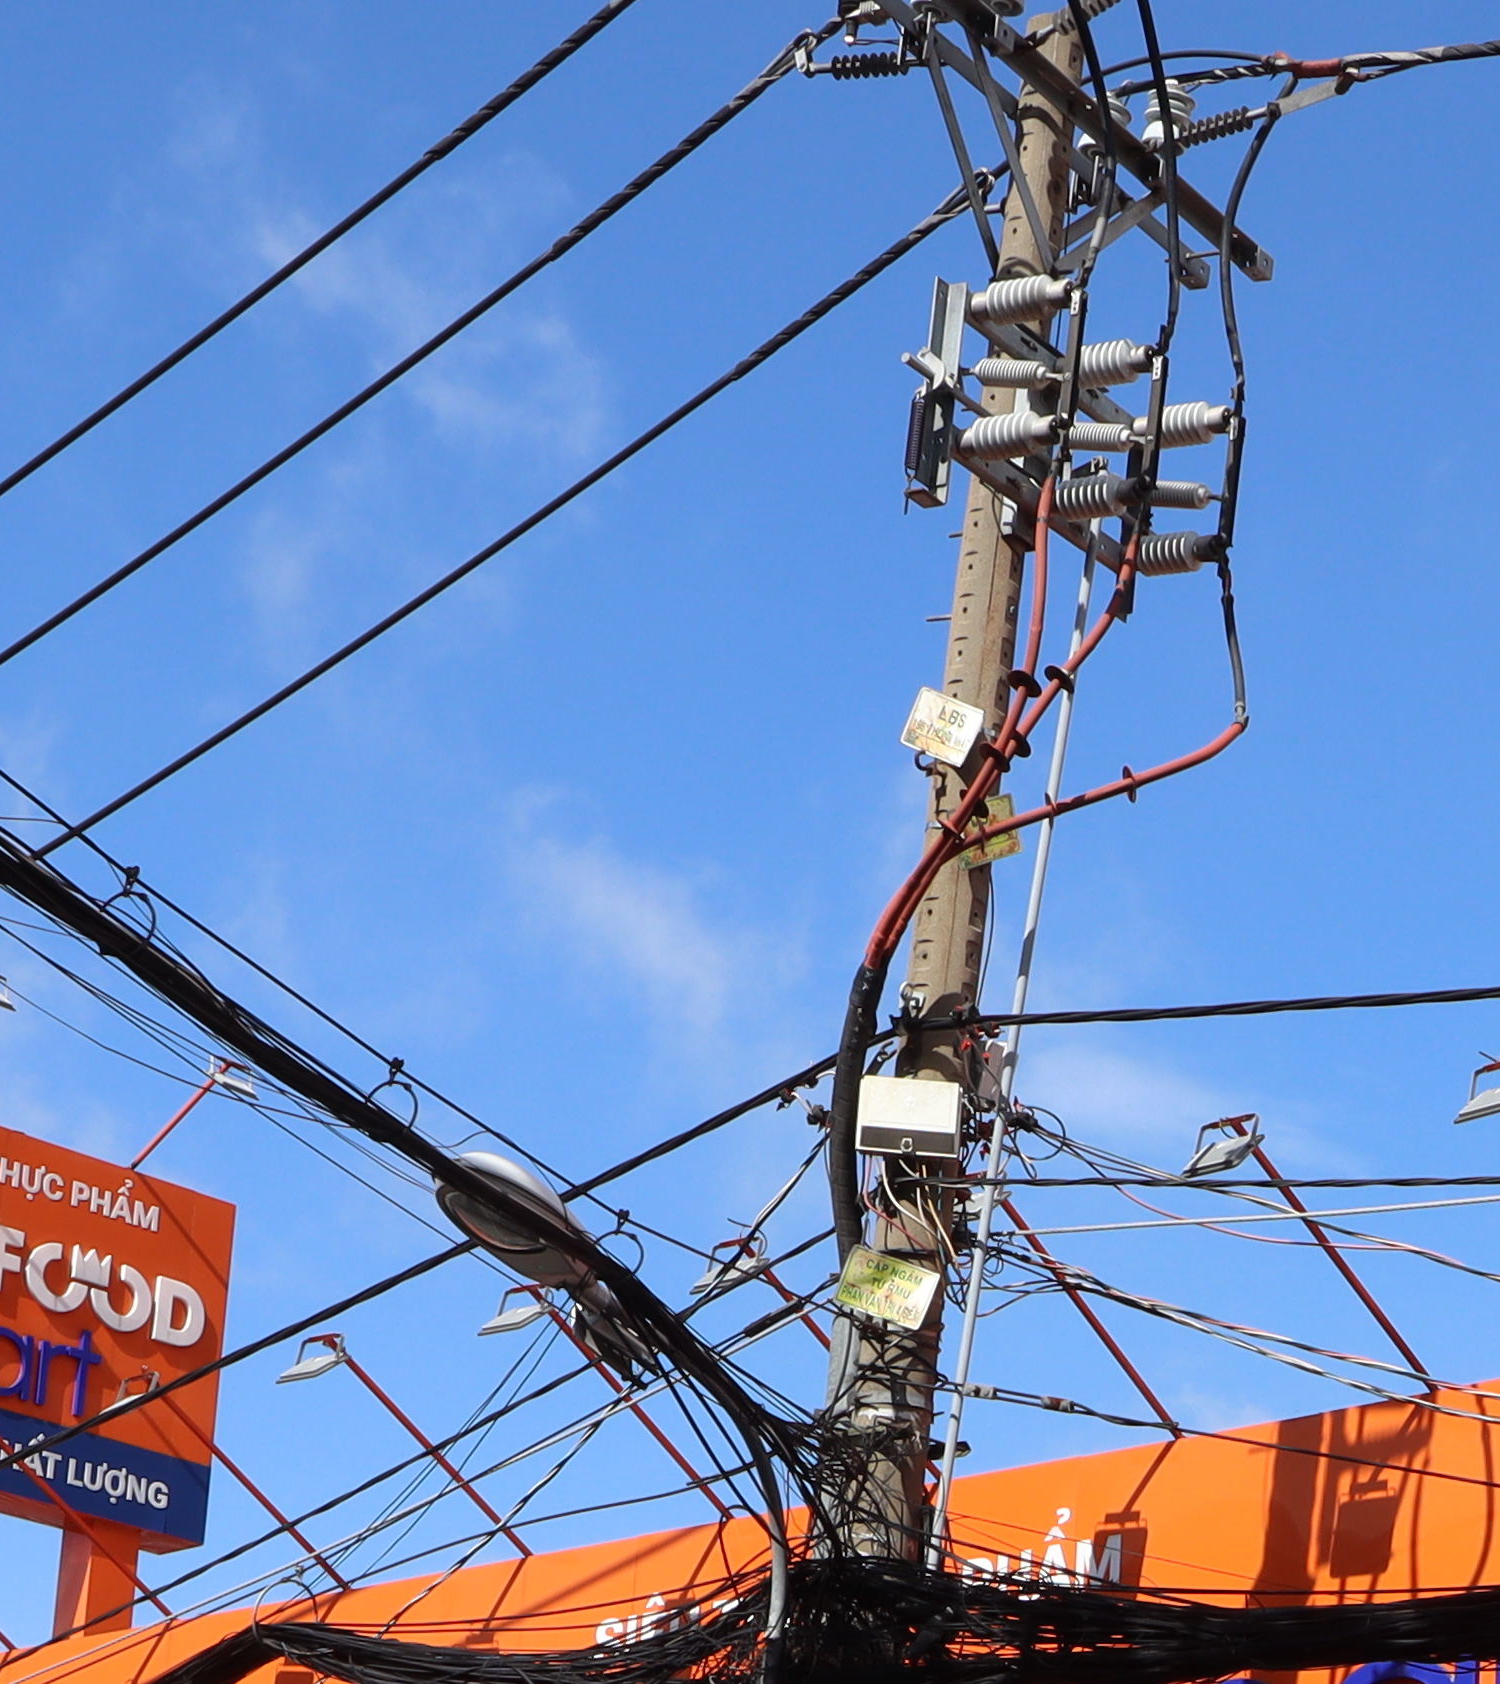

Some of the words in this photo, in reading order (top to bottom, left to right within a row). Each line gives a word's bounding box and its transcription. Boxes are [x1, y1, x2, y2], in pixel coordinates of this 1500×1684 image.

[938, 705, 968, 729] LBS
[70, 1177, 161, 1234] PHẨM
[66, 1458, 170, 1511] LƯỢNG
